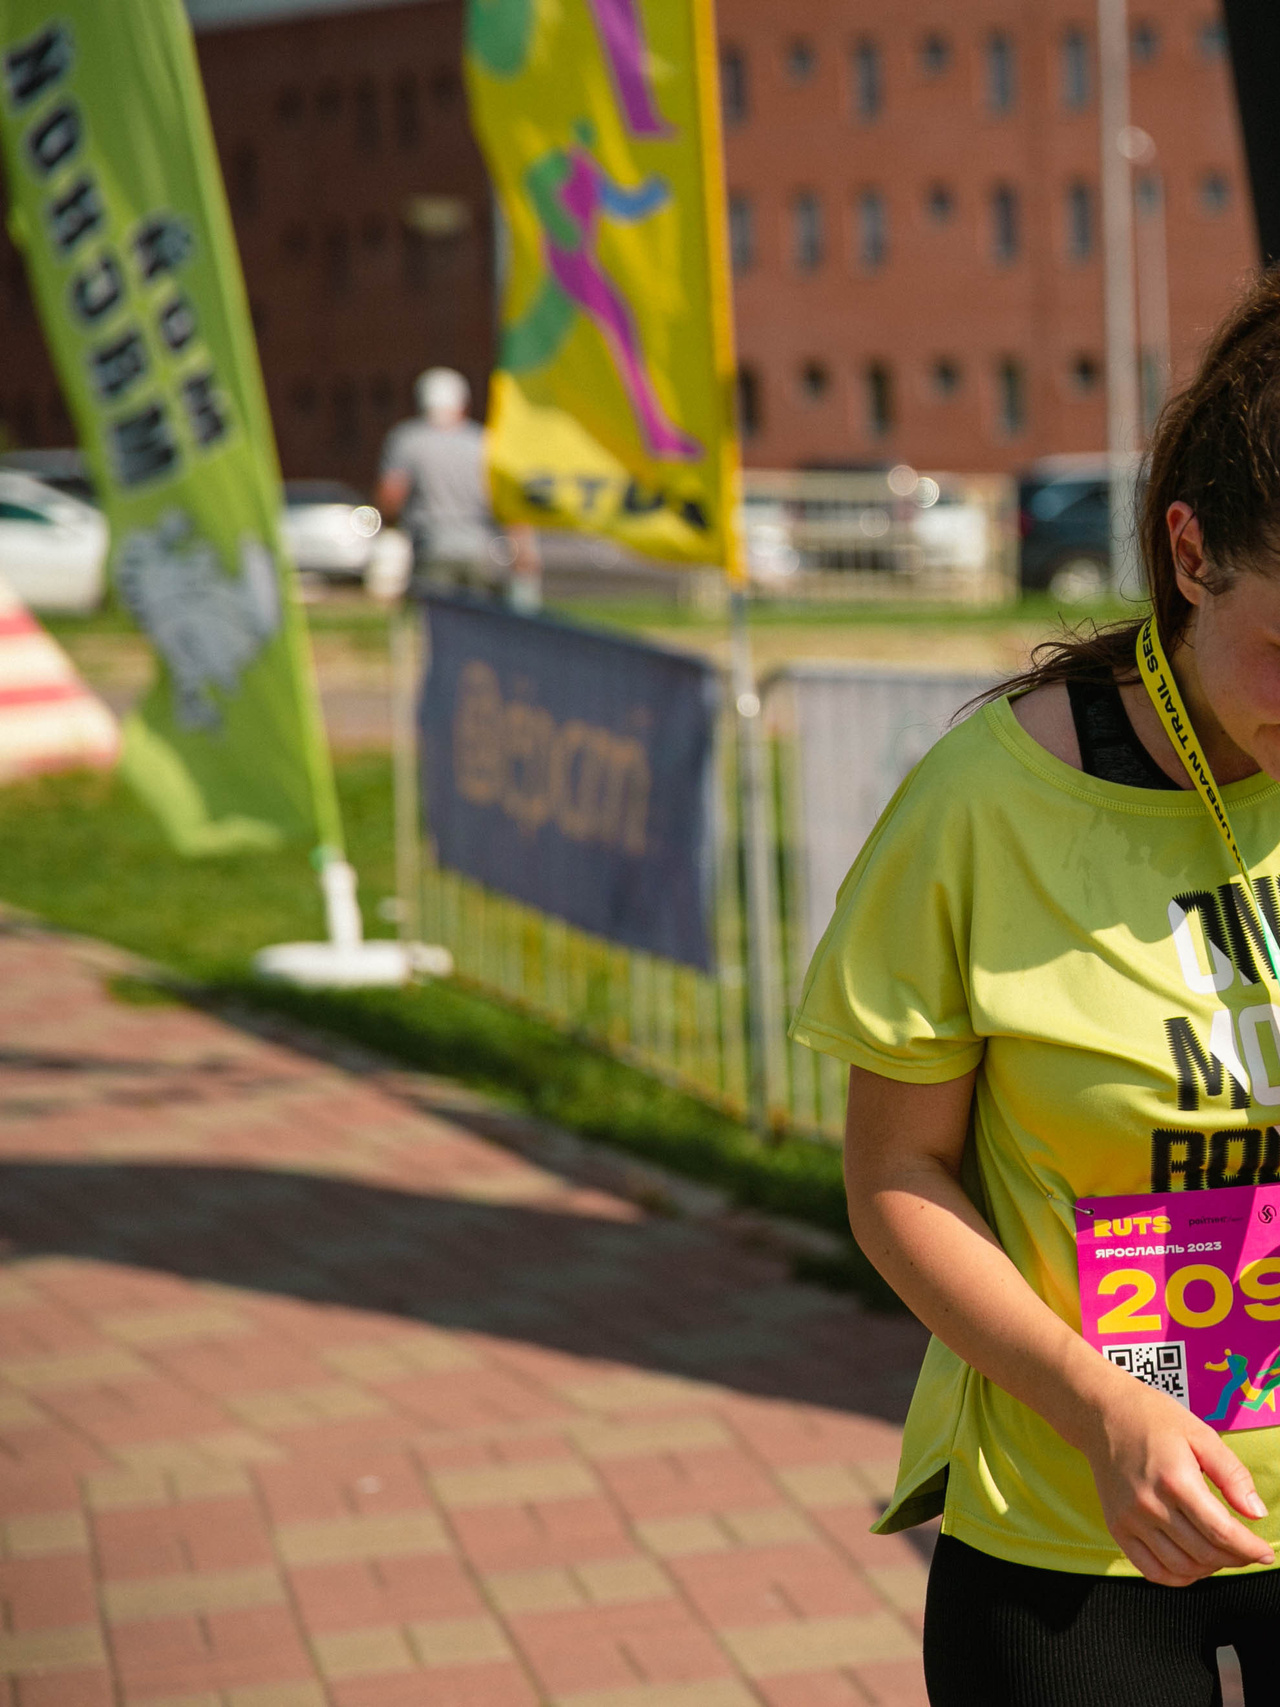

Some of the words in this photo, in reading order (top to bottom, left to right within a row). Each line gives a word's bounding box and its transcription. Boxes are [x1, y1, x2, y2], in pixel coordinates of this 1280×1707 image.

[1156, 674, 1190, 750] TRAIL
[1188, 751, 1231, 840] URBAN
[1093, 1215, 1172, 1238] RUTS
[1095, 1243, 1185, 1259] ЯРОСЛАВЛЬ
[1187, 1241, 1222, 1252] 2023
